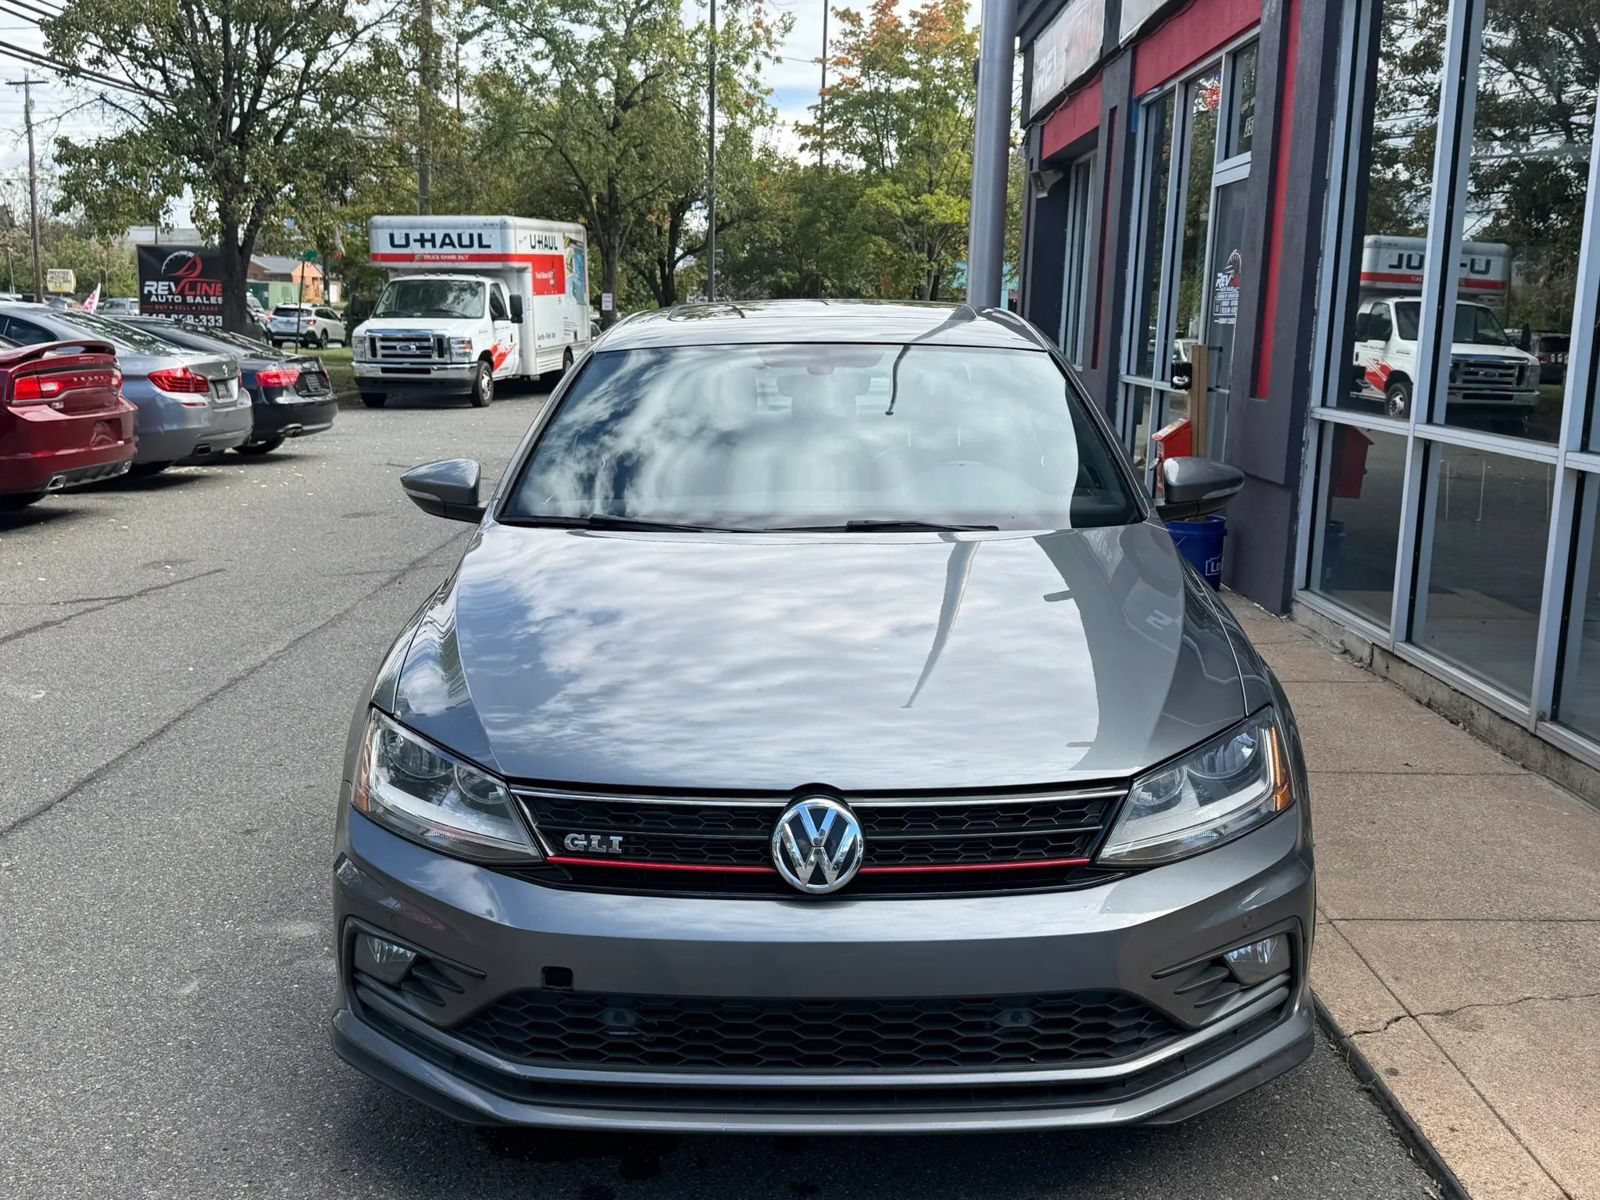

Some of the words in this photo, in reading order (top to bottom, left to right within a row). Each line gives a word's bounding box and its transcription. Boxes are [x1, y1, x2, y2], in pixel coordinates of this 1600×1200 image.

[389, 233, 492, 249] U-HAUL
[529, 234, 558, 251] U-HAUL
[150, 295, 182, 303] AUTO
[564, 833, 624, 854] GLI
